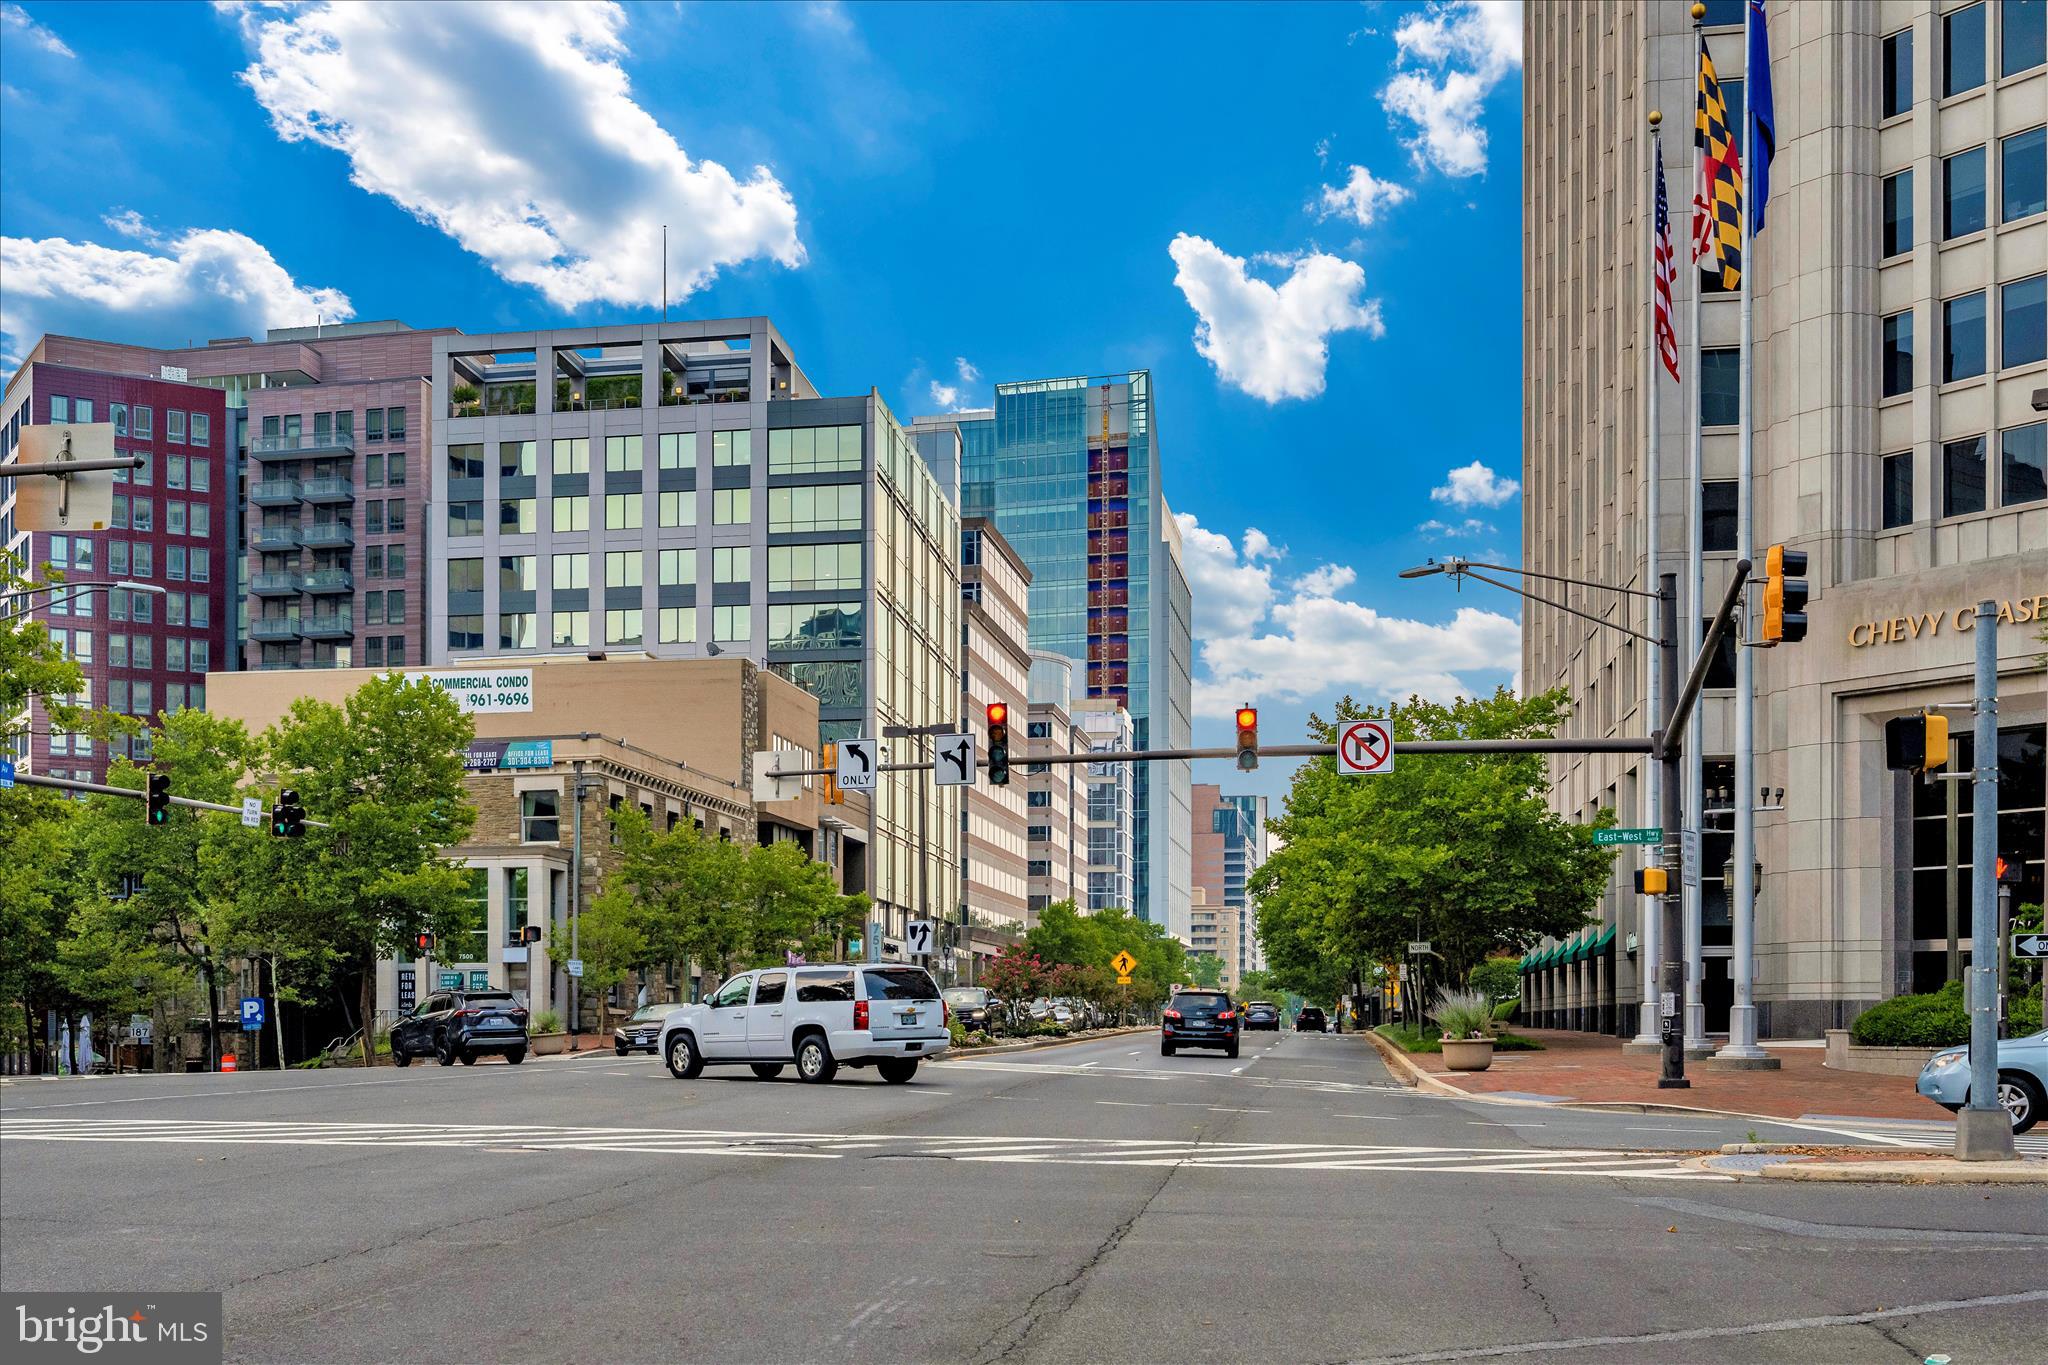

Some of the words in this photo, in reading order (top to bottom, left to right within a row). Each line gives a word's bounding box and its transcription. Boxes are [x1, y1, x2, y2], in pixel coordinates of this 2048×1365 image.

[1848, 610, 1945, 648] CHEVY
[1951, 594, 2048, 632] CASE
[432, 676, 492, 690] COMMERCIAL
[496, 675, 529, 688] CONDO
[470, 692, 529, 707] 961-9696
[842, 775, 871, 785] ONLY
[1598, 832, 1642, 841] East-West
[243, 1001, 260, 1019] P
[132, 1028, 148, 1037] 187
